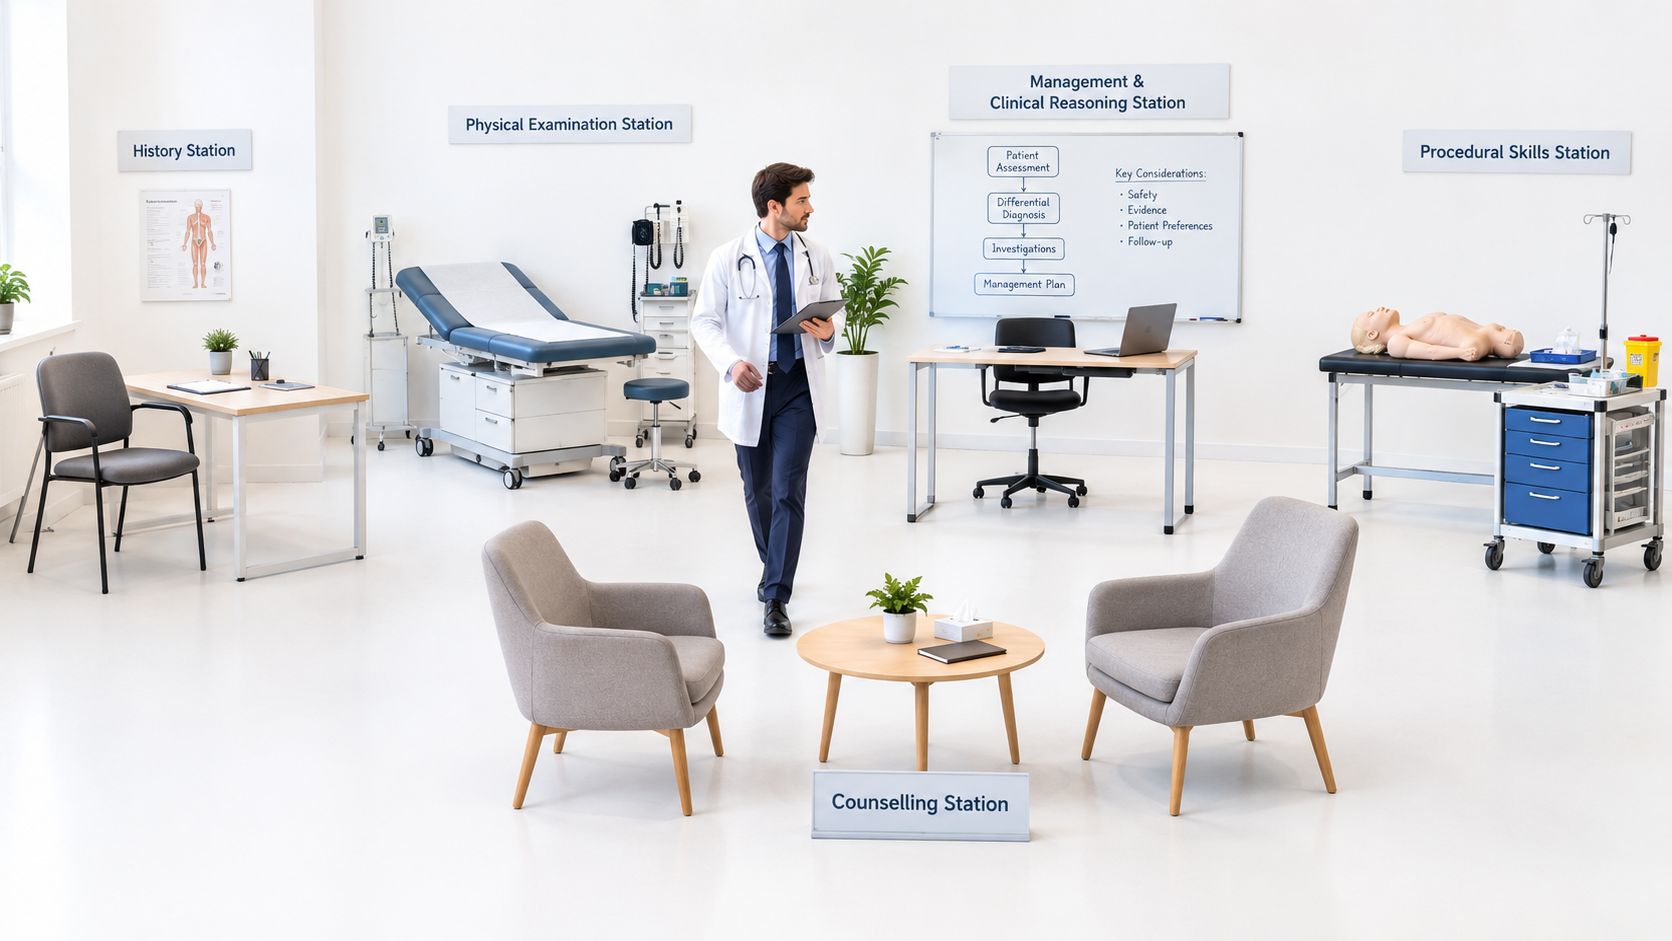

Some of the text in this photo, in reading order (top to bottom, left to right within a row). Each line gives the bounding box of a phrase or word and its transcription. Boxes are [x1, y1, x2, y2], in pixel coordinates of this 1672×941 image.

[1031, 74, 1144, 91] Management &
[991, 96, 1185, 112] Clinical Reasoning Station
[467, 117, 672, 134] Physical Examination Station
[134, 144, 235, 160] History Station
[1007, 151, 1038, 159] Patient
[1421, 145, 1609, 159] Procedural Skills Station
[996, 163, 1049, 172] Assessment
[1116, 168, 1206, 180] Key Considerations:
[998, 197, 1049, 206] Differential
[1128, 189, 1157, 202] Safety
[1003, 210, 1045, 222] Diagnosis
[1128, 205, 1166, 214] Evidence
[1129, 220, 1212, 230] Patient Preferences
[1129, 236, 1173, 249] Follow-up
[993, 243, 1056, 256] Investigations
[984, 279, 1065, 291] Management Plan
[832, 793, 1008, 815] Counselling Station
